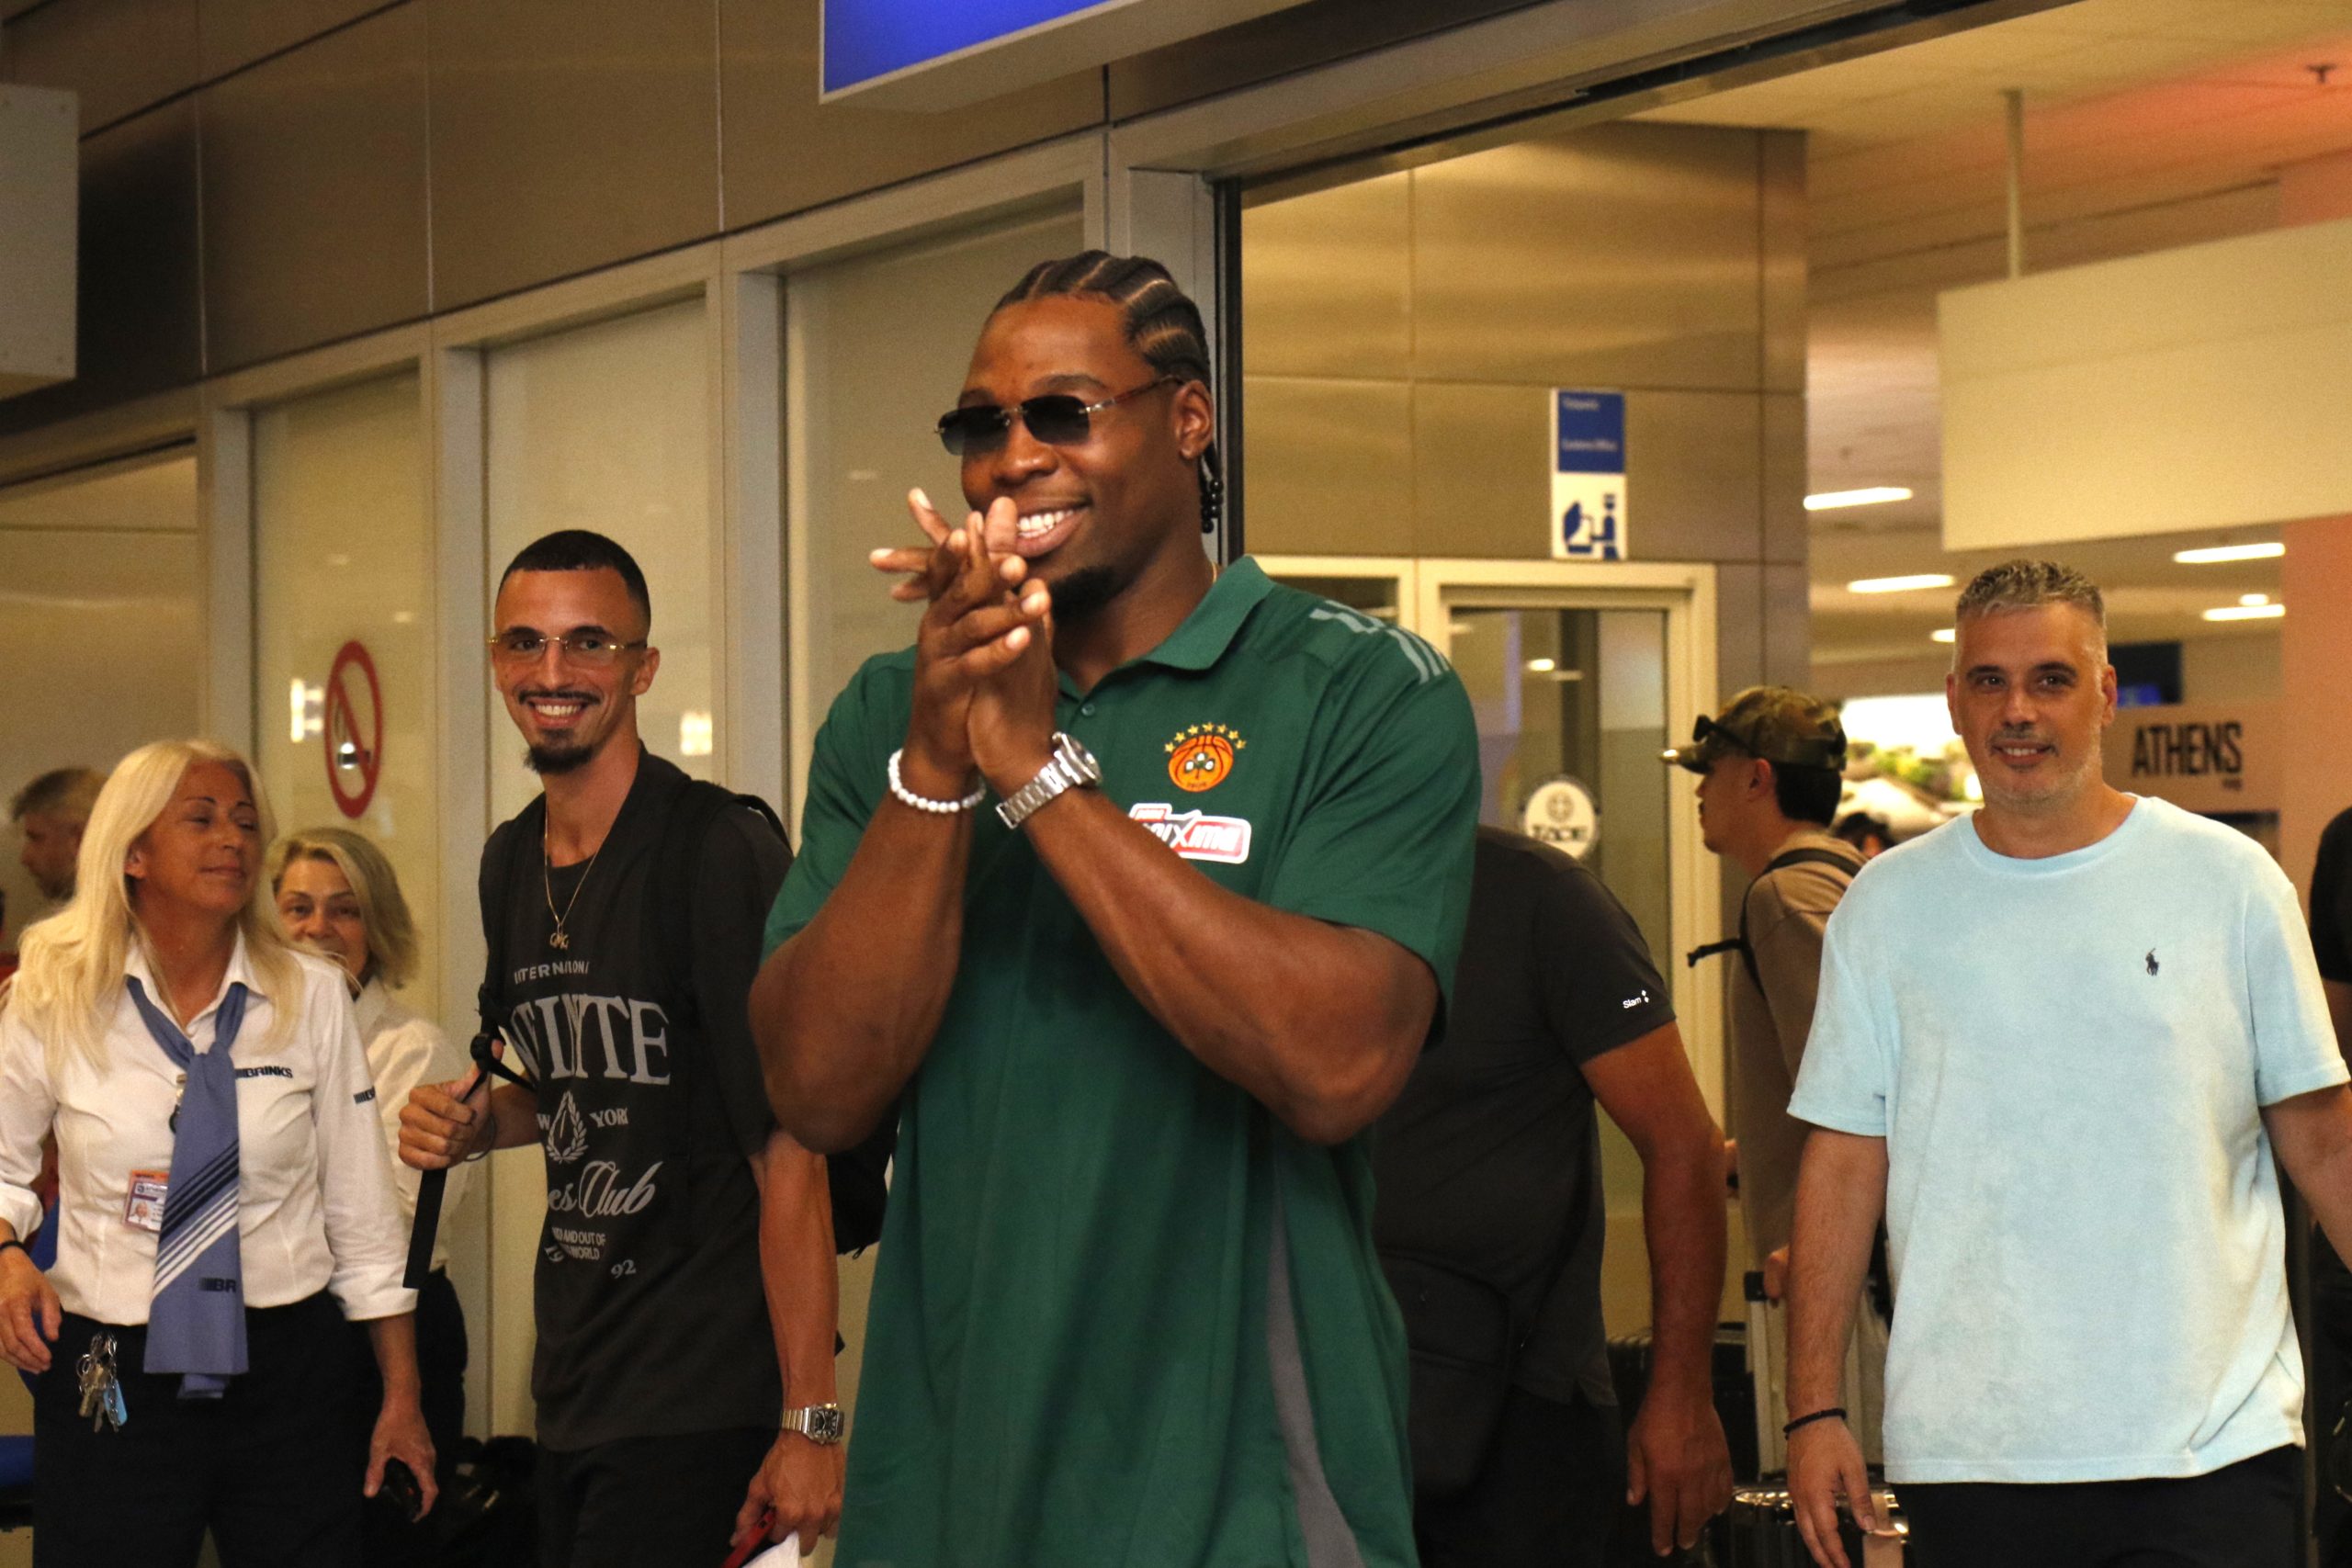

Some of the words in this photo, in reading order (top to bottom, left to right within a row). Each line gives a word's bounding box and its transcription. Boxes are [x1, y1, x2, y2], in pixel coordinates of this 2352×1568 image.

[2132, 721, 2243, 776] ATHENS
[1623, 997, 1642, 1009] Slam
[245, 1066, 293, 1078] BRINKS
[578, 1160, 663, 1219] Club
[578, 1231, 595, 1245] OUT
[595, 1232, 606, 1247] OF
[610, 1258, 637, 1280] 92
